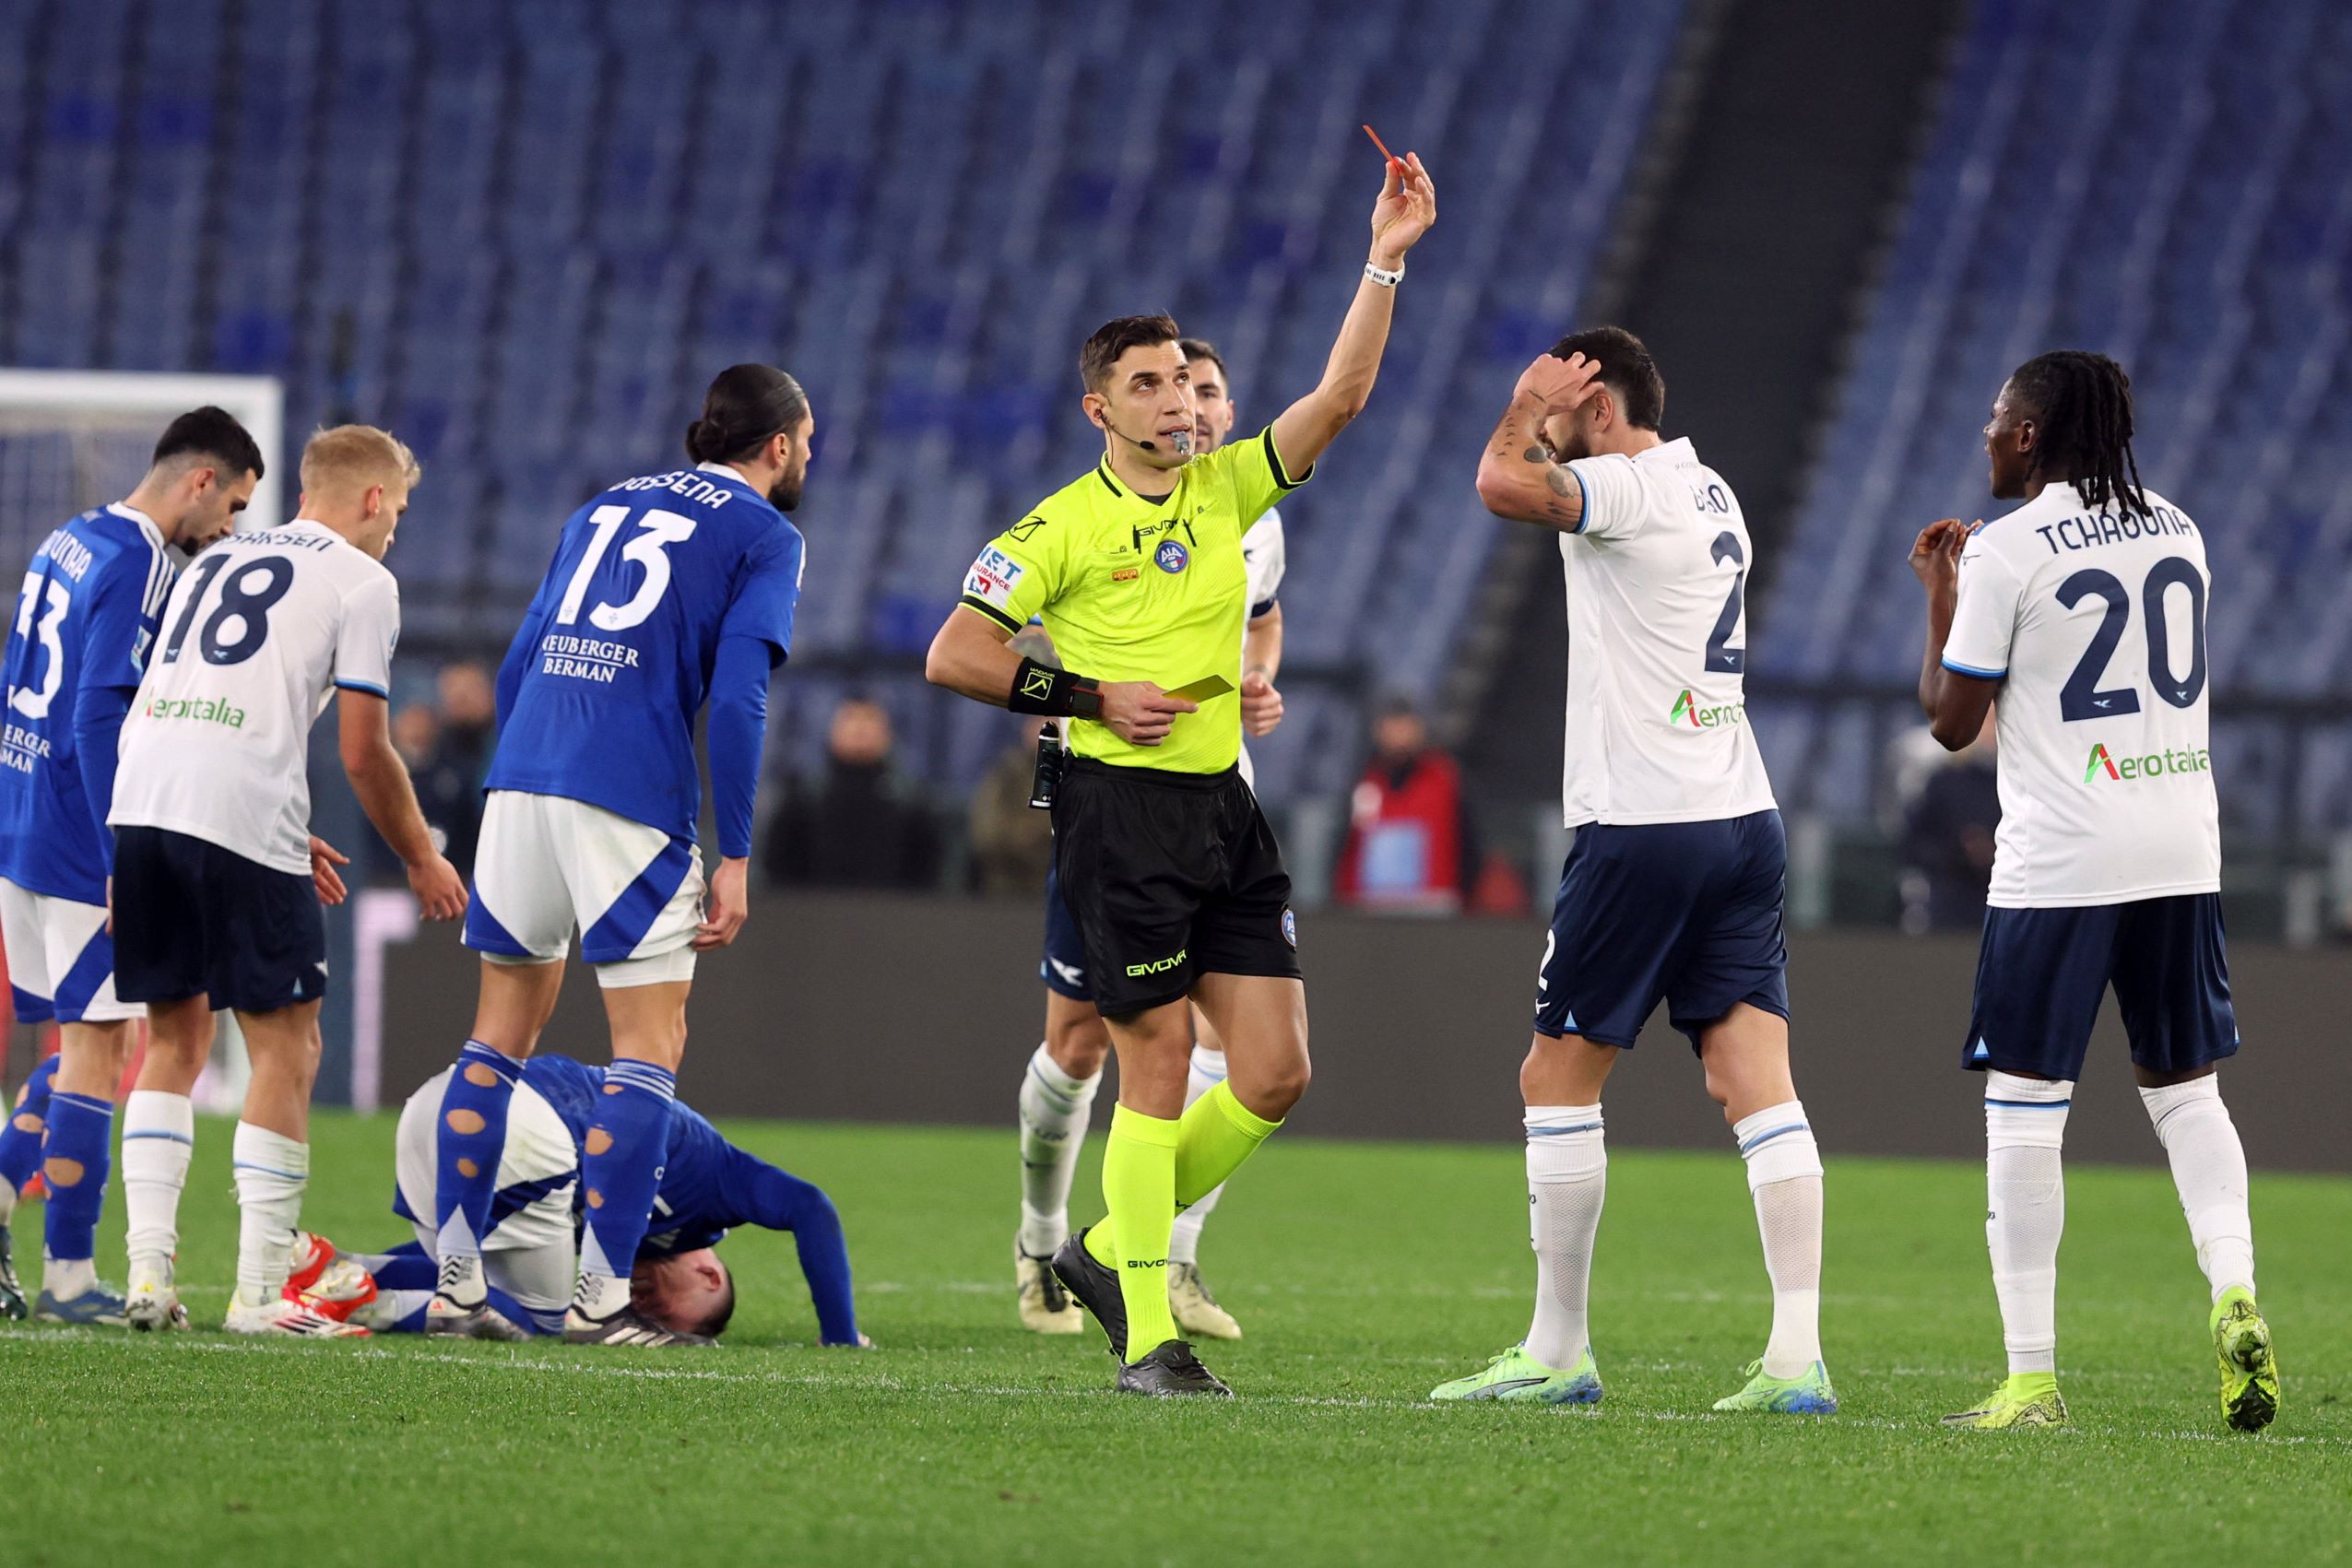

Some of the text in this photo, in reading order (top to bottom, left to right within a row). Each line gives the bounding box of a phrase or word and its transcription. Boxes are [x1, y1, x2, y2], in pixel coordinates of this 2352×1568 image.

[556, 504, 697, 631] 13
[2036, 506, 2193, 555] TCHAOUNA
[163, 553, 294, 665] 18
[1704, 530, 1745, 674] 2
[2055, 556, 2206, 723] 20
[542, 657, 617, 684] BERMAN
[1126, 949, 1187, 977] GIVOVA
[1537, 927, 1555, 992] 2
